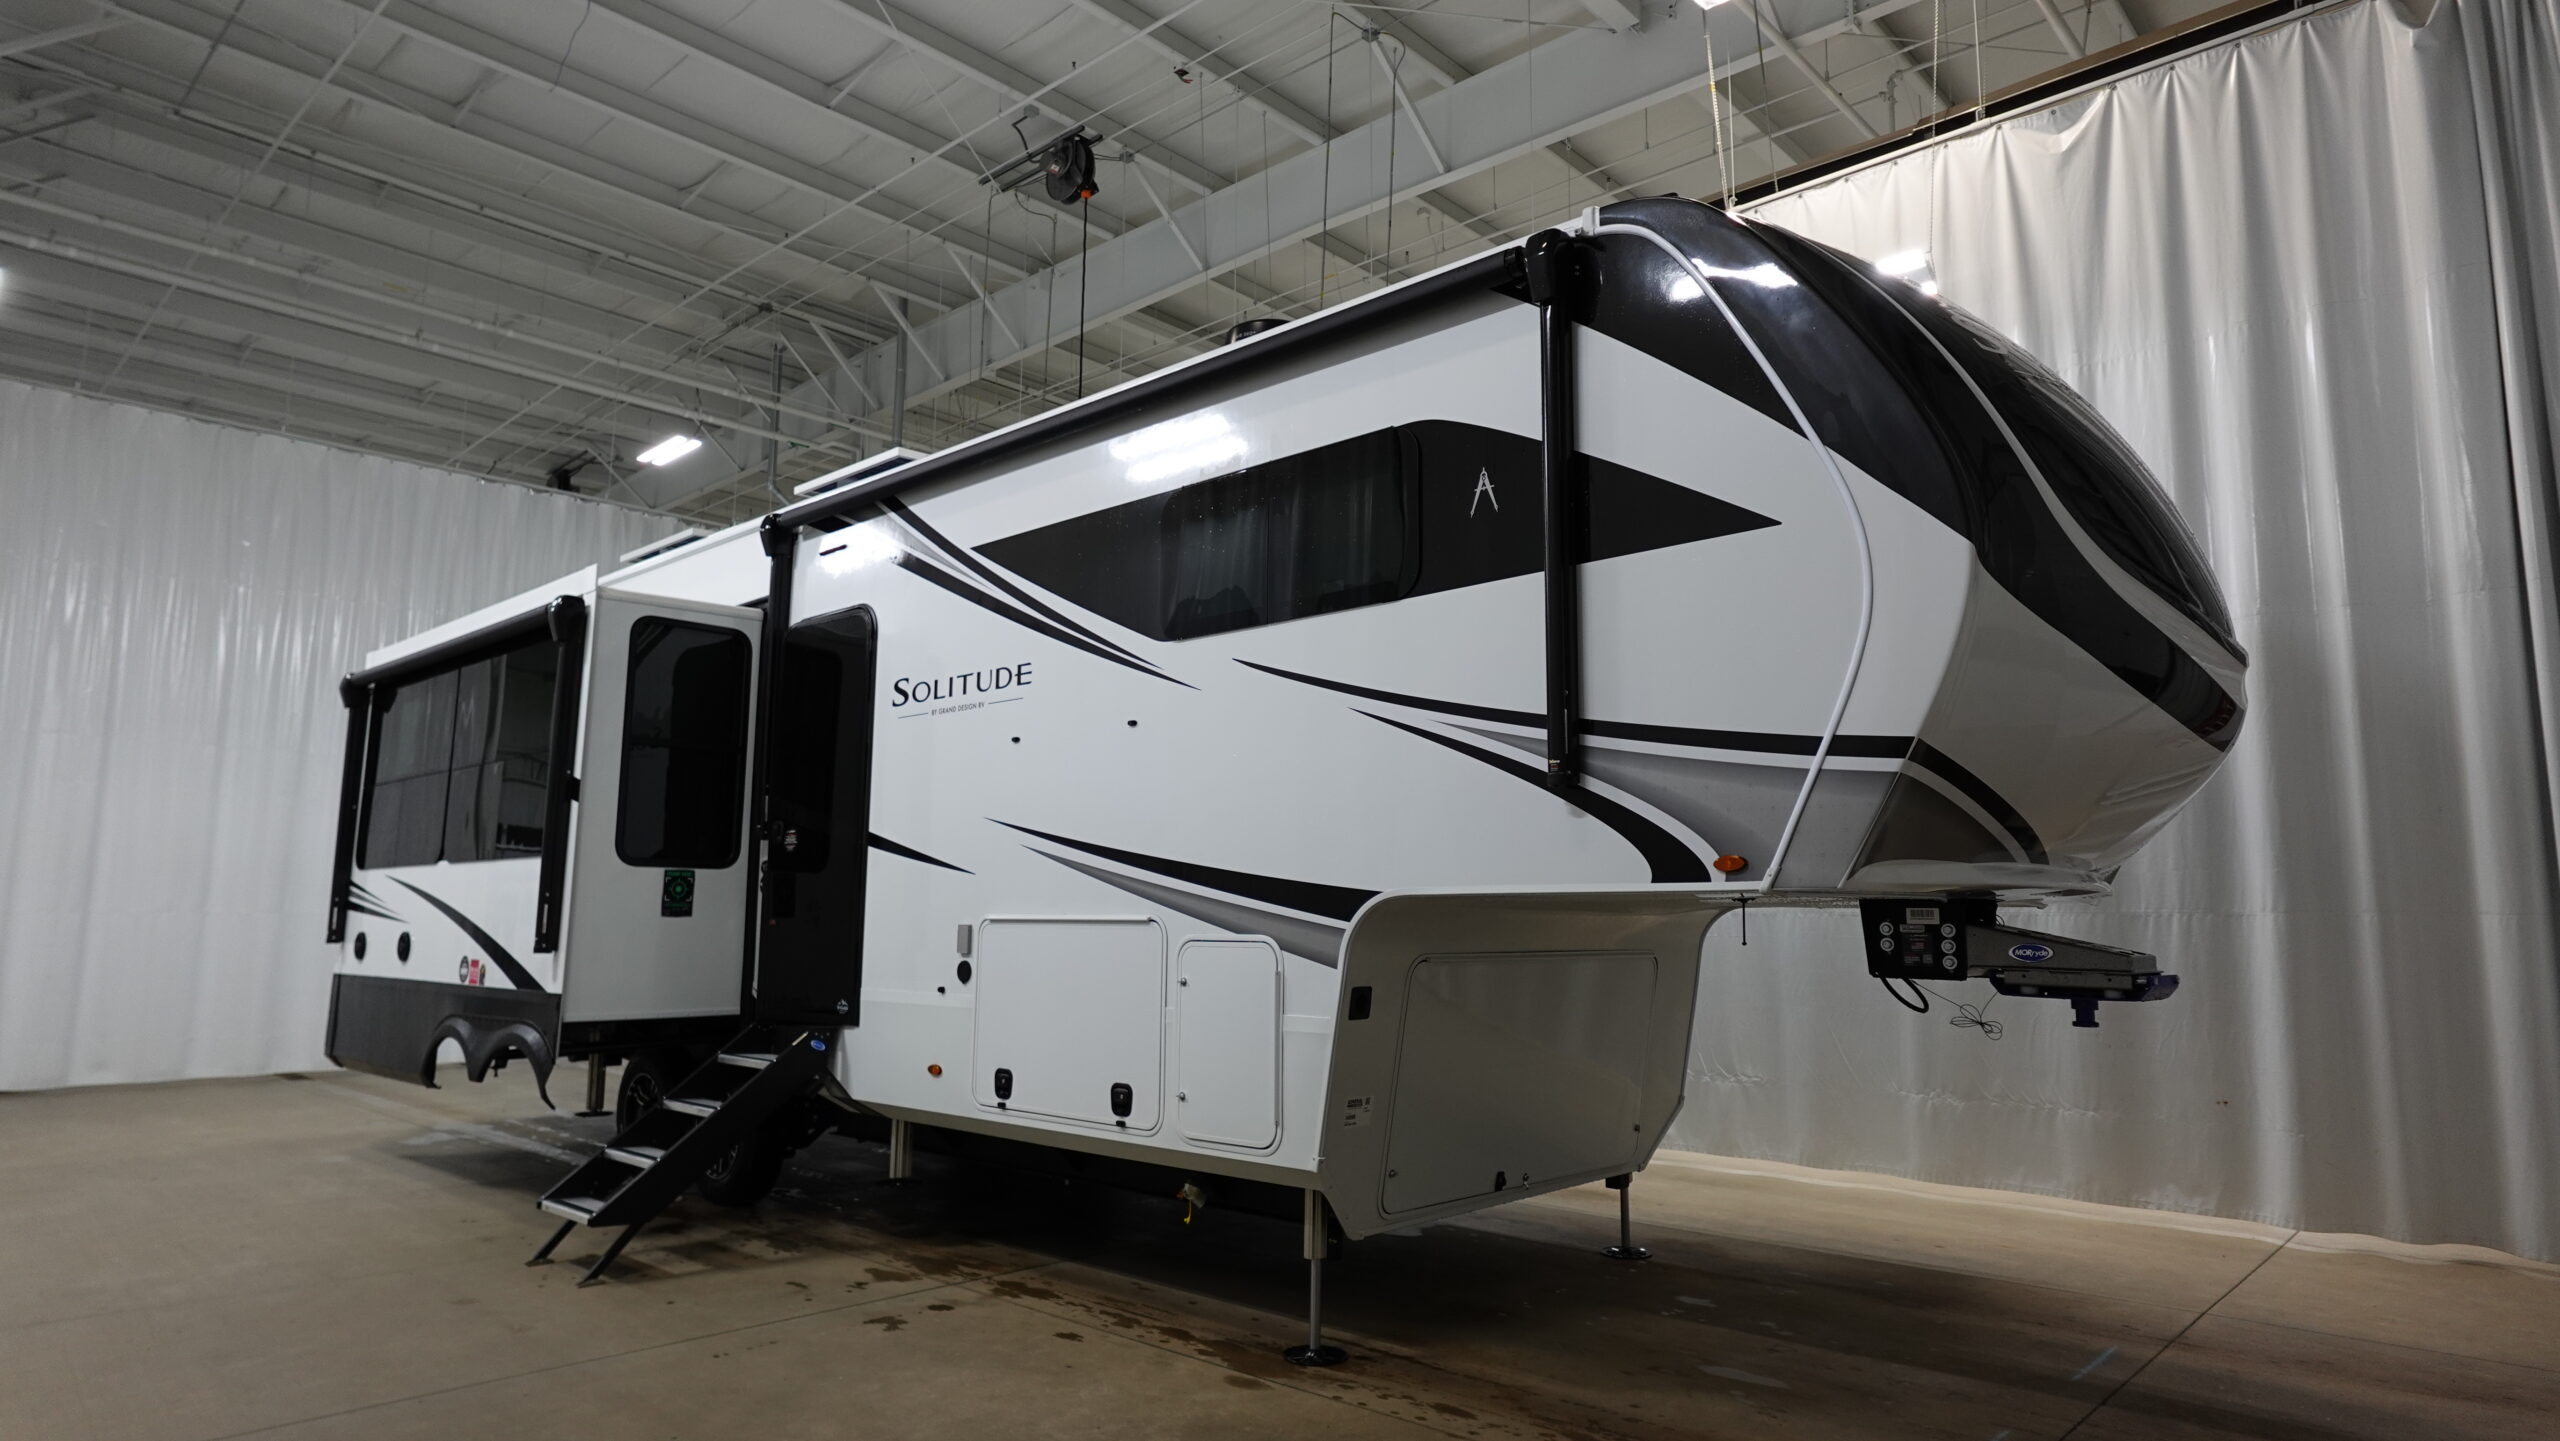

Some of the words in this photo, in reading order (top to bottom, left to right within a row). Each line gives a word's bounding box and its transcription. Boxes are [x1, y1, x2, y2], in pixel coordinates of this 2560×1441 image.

[892, 662, 1033, 708] SOLITUDE
[938, 705, 956, 715] GRAND
[957, 703, 977, 712] DESIGN
